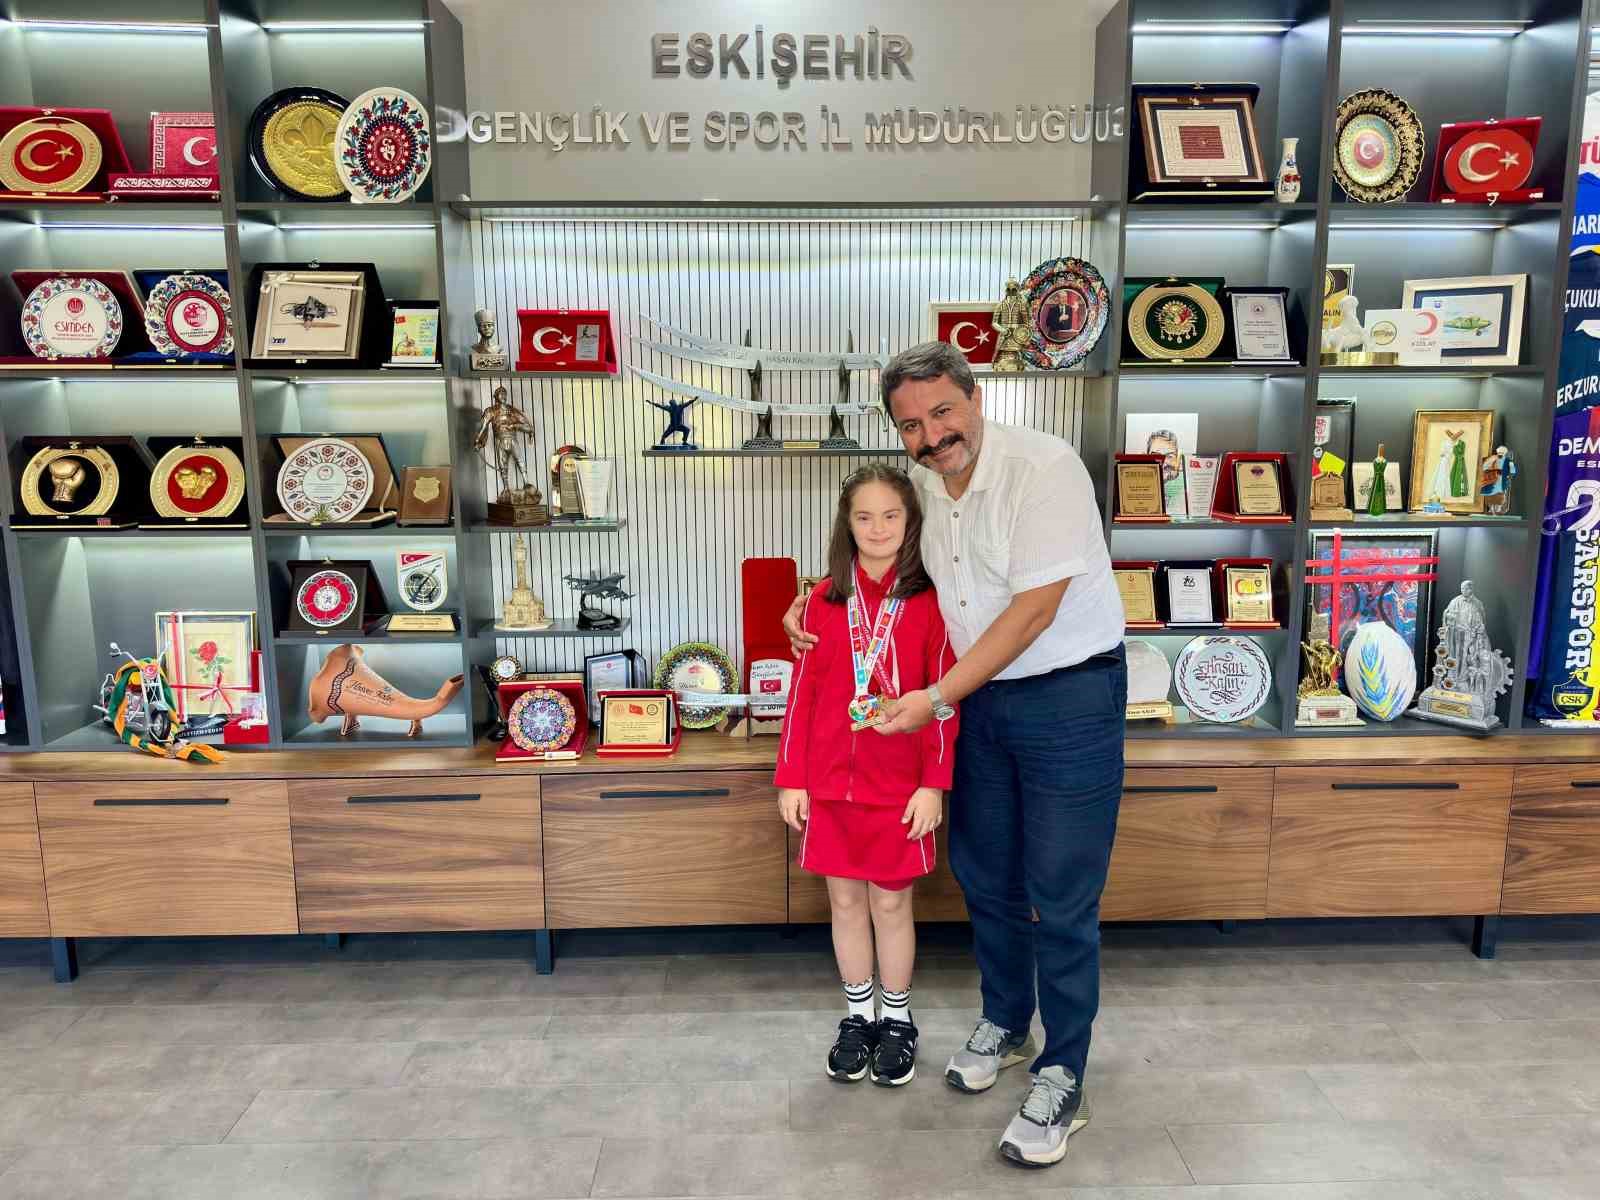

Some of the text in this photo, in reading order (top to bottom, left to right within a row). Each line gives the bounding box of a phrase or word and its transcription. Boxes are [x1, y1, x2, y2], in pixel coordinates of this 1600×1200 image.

[652, 25, 913, 88] ESKİŞEHİR
[467, 104, 1093, 153] GENÇLİK VE SPOR İL MÜDÜRLÜĞÜ
[1556, 375, 1600, 408] ERZUR
